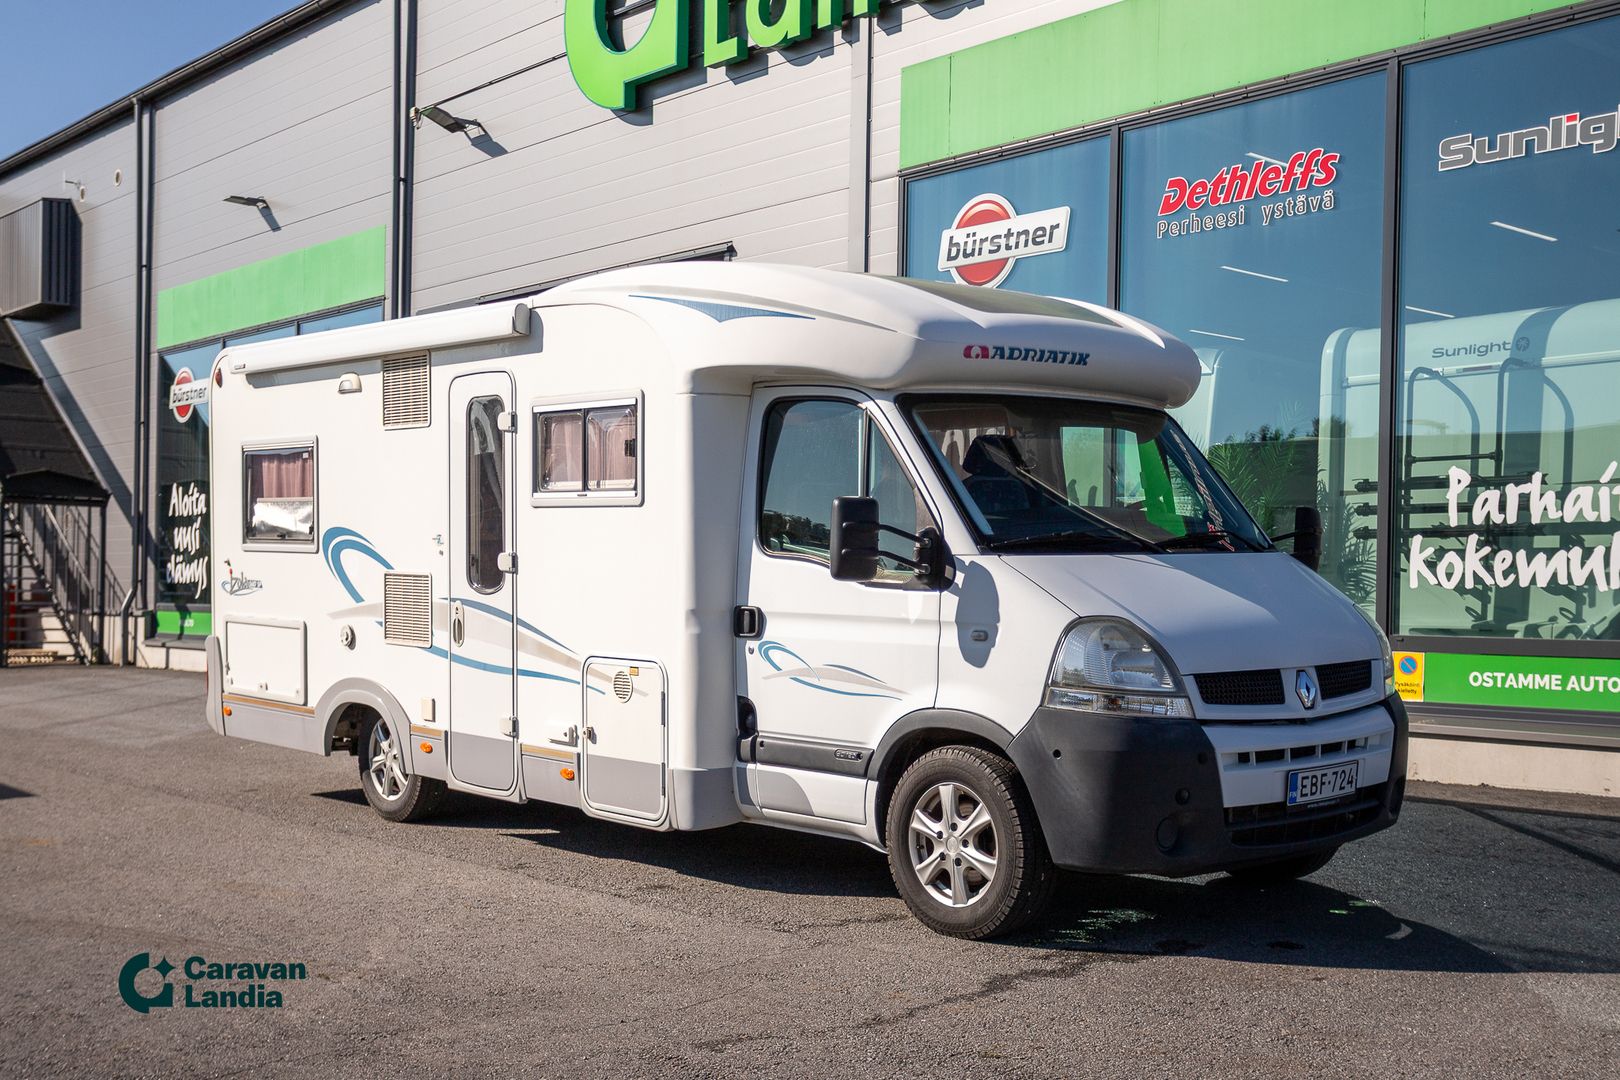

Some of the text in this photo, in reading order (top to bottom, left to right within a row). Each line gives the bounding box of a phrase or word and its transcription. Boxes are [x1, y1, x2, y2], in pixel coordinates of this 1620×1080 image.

[1438, 103, 1620, 172] Sunlig
[1158, 148, 1340, 216] Dethleffs
[1156, 189, 1335, 239] Perheesi ystävä
[946, 222, 1060, 262] bürstner
[990, 345, 1090, 367] ADRIATIK
[1431, 340, 1512, 359] Sunlight
[172, 386, 207, 404] bürstner
[168, 482, 207, 518] Aloita
[173, 516, 202, 556] uusi
[166, 553, 209, 600] elämys
[1468, 671, 1620, 693] OSTAMME AUTO
[1300, 767, 1354, 798] EBF-724
